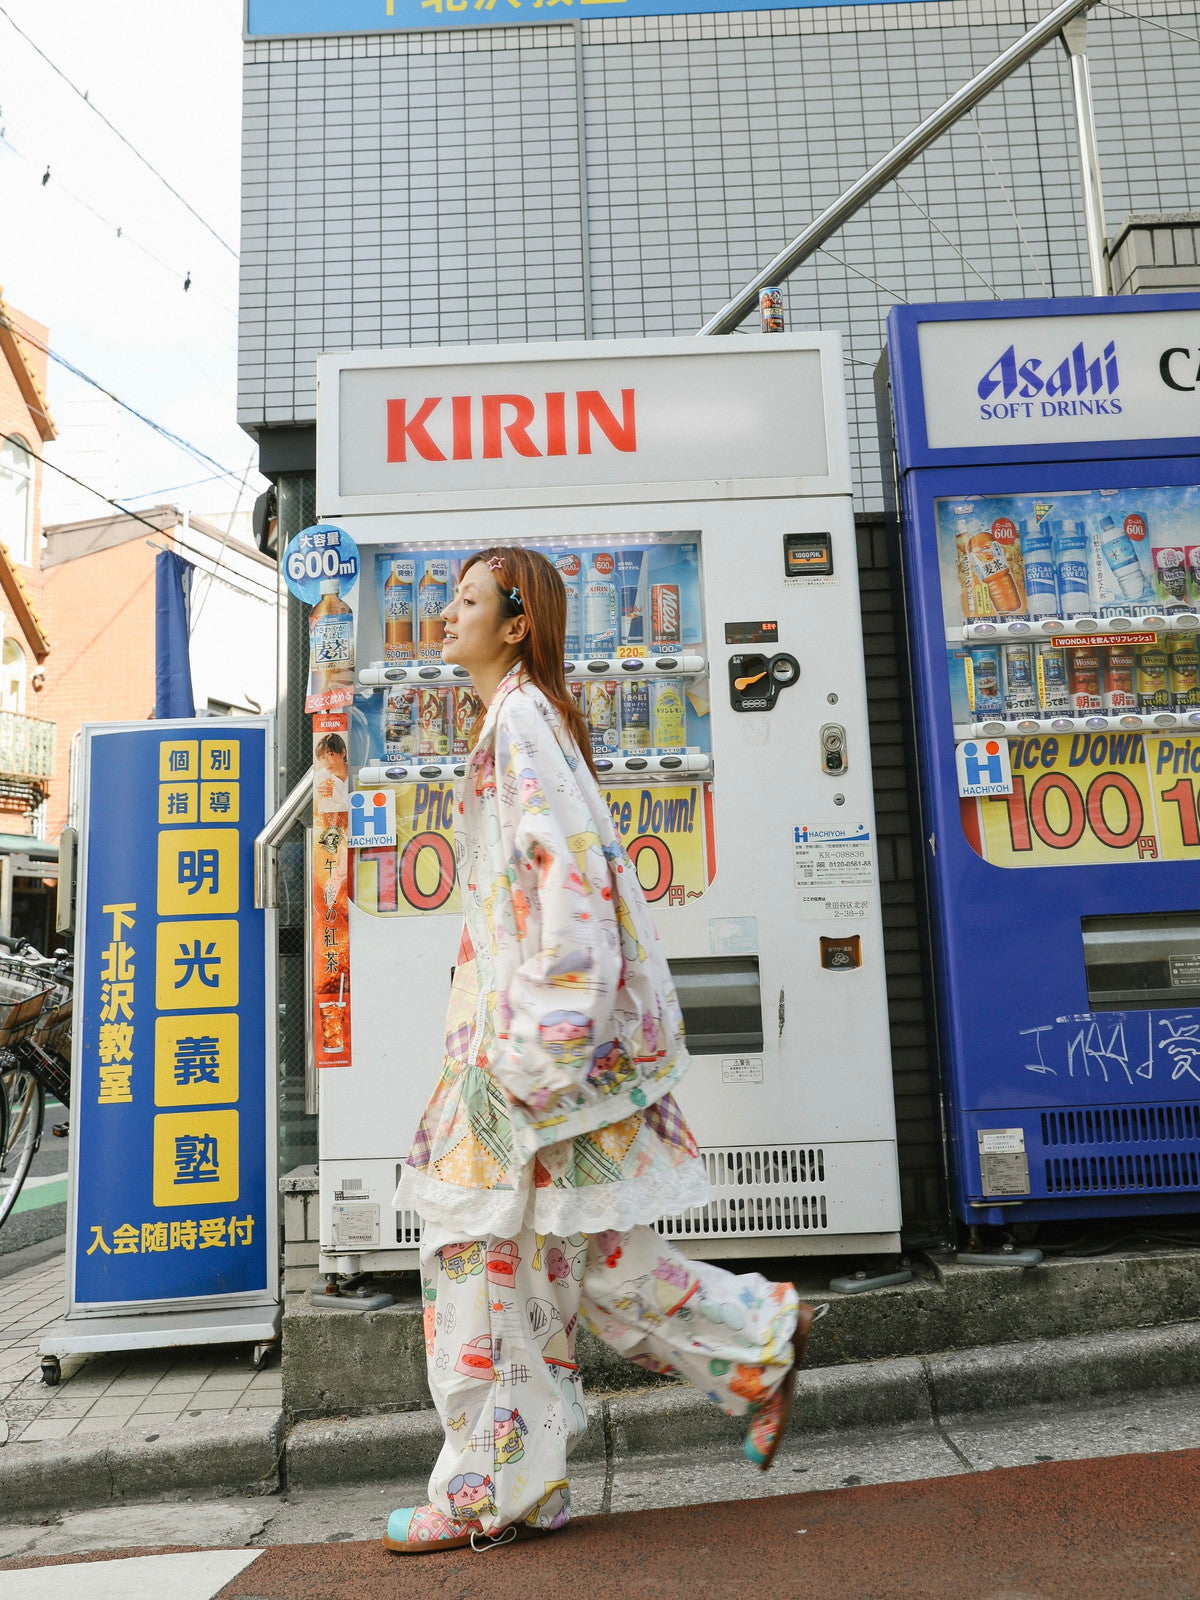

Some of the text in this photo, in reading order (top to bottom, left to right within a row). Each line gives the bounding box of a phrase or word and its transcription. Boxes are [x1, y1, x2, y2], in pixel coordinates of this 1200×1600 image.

[978, 340, 1120, 400] Asahi
[1159, 347, 1200, 391] C
[980, 398, 1122, 420] SOFT DRINKS
[385, 388, 637, 463] KIRIN
[299, 531, 340, 549] 大容量
[288, 549, 356, 580] 600ml
[316, 639, 348, 661] 麦茶
[1055, 634, 1153, 647] 「WONDA」を飲んでリフレッシュ!
[386, 649, 411, 658] 600ml
[420, 648, 442, 657] 600m
[1075, 658, 1099, 667] WONDA
[1111, 656, 1134, 665] WONDA
[1005, 699, 1036, 709] 帰ってきた
[1046, 698, 1069, 708] ってきた
[169, 749, 231, 772] 個別
[1008, 733, 1146, 770] rice Down
[1156, 739, 1200, 775] Pric
[963, 784, 1010, 796] HACHIYOH
[167, 791, 231, 815] 指導
[413, 783, 454, 831] Pric
[637, 787, 697, 834] Down!
[1161, 778, 1200, 846] 1
[347, 836, 393, 847] HACHIYOH
[323, 858, 340, 974] 午後の紅茶
[825, 900, 869, 910] 世田谷区北沢
[97, 902, 137, 1104] 下北沢教室
[174, 848, 222, 1185] 明光義塾
[86, 1214, 255, 1256] 入会随時受付
